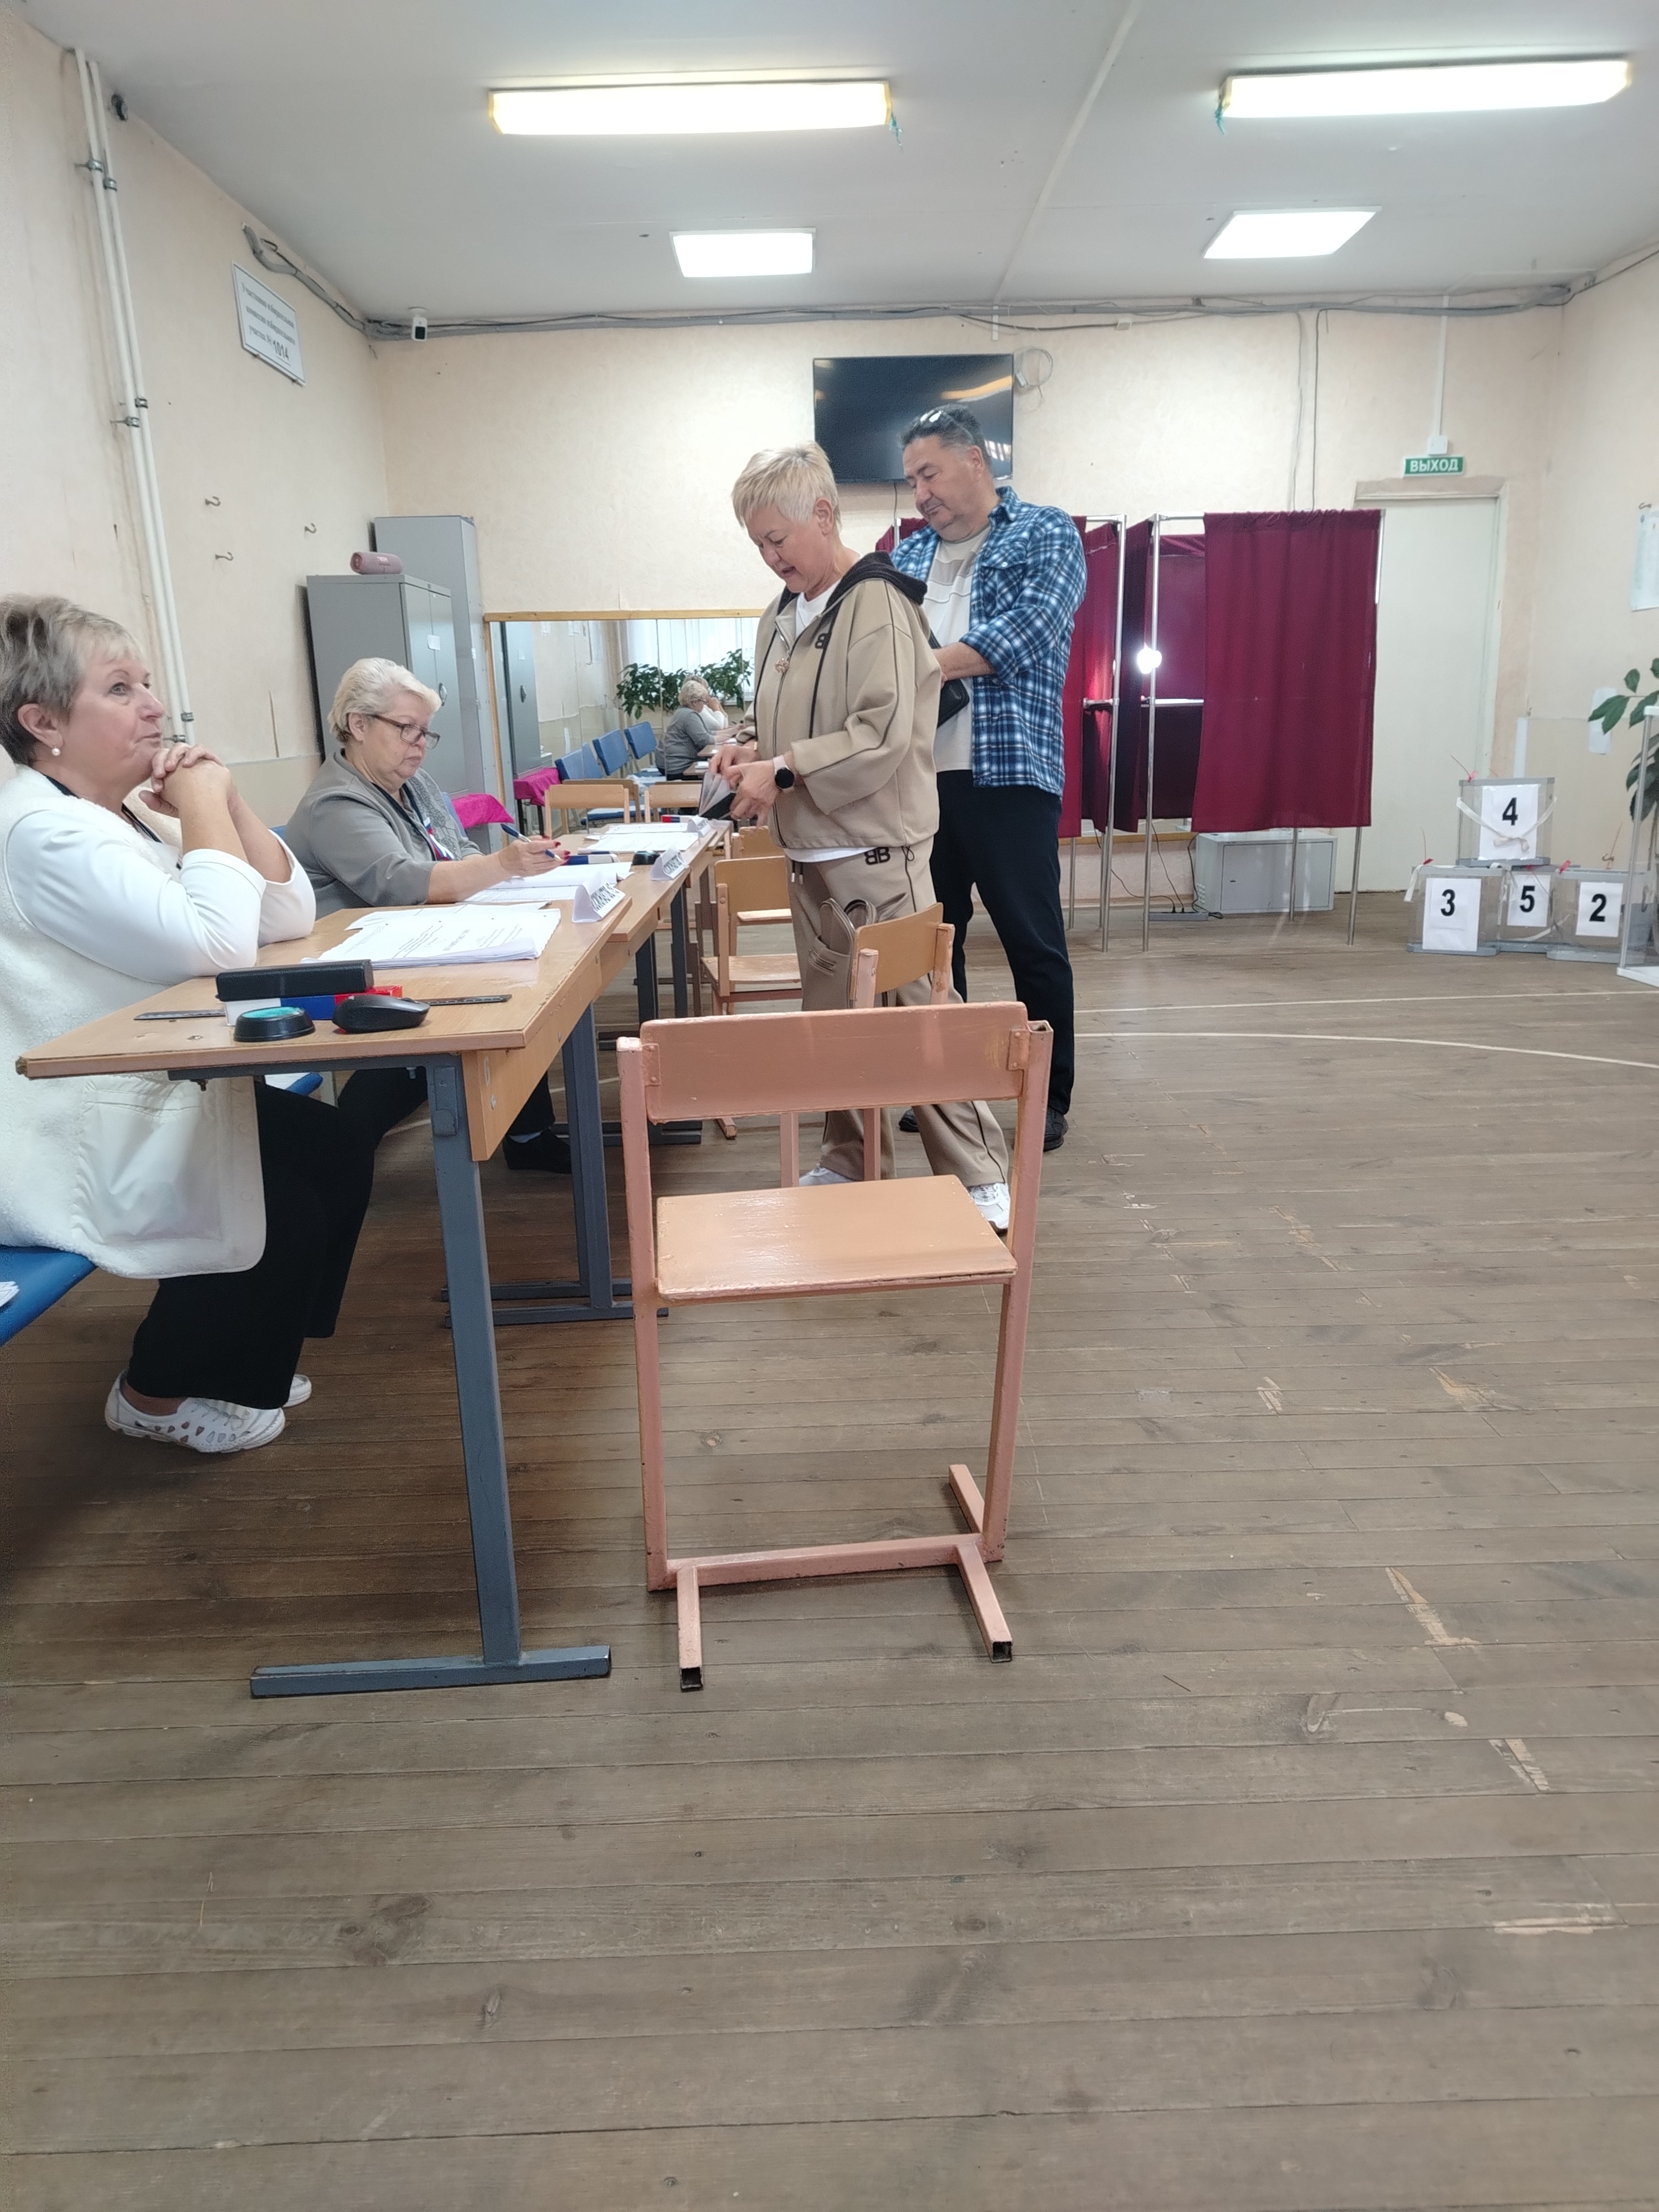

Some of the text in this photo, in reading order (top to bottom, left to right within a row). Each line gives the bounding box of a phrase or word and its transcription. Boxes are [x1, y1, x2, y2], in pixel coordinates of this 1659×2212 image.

[273, 340, 289, 361] 1014
[1410, 458, 1459, 472] ВЫХОД
[1502, 797, 1519, 826] 4
[1440, 889, 1455, 916] 3
[1520, 886, 1535, 912] 5
[1589, 894, 1607, 922] 2
